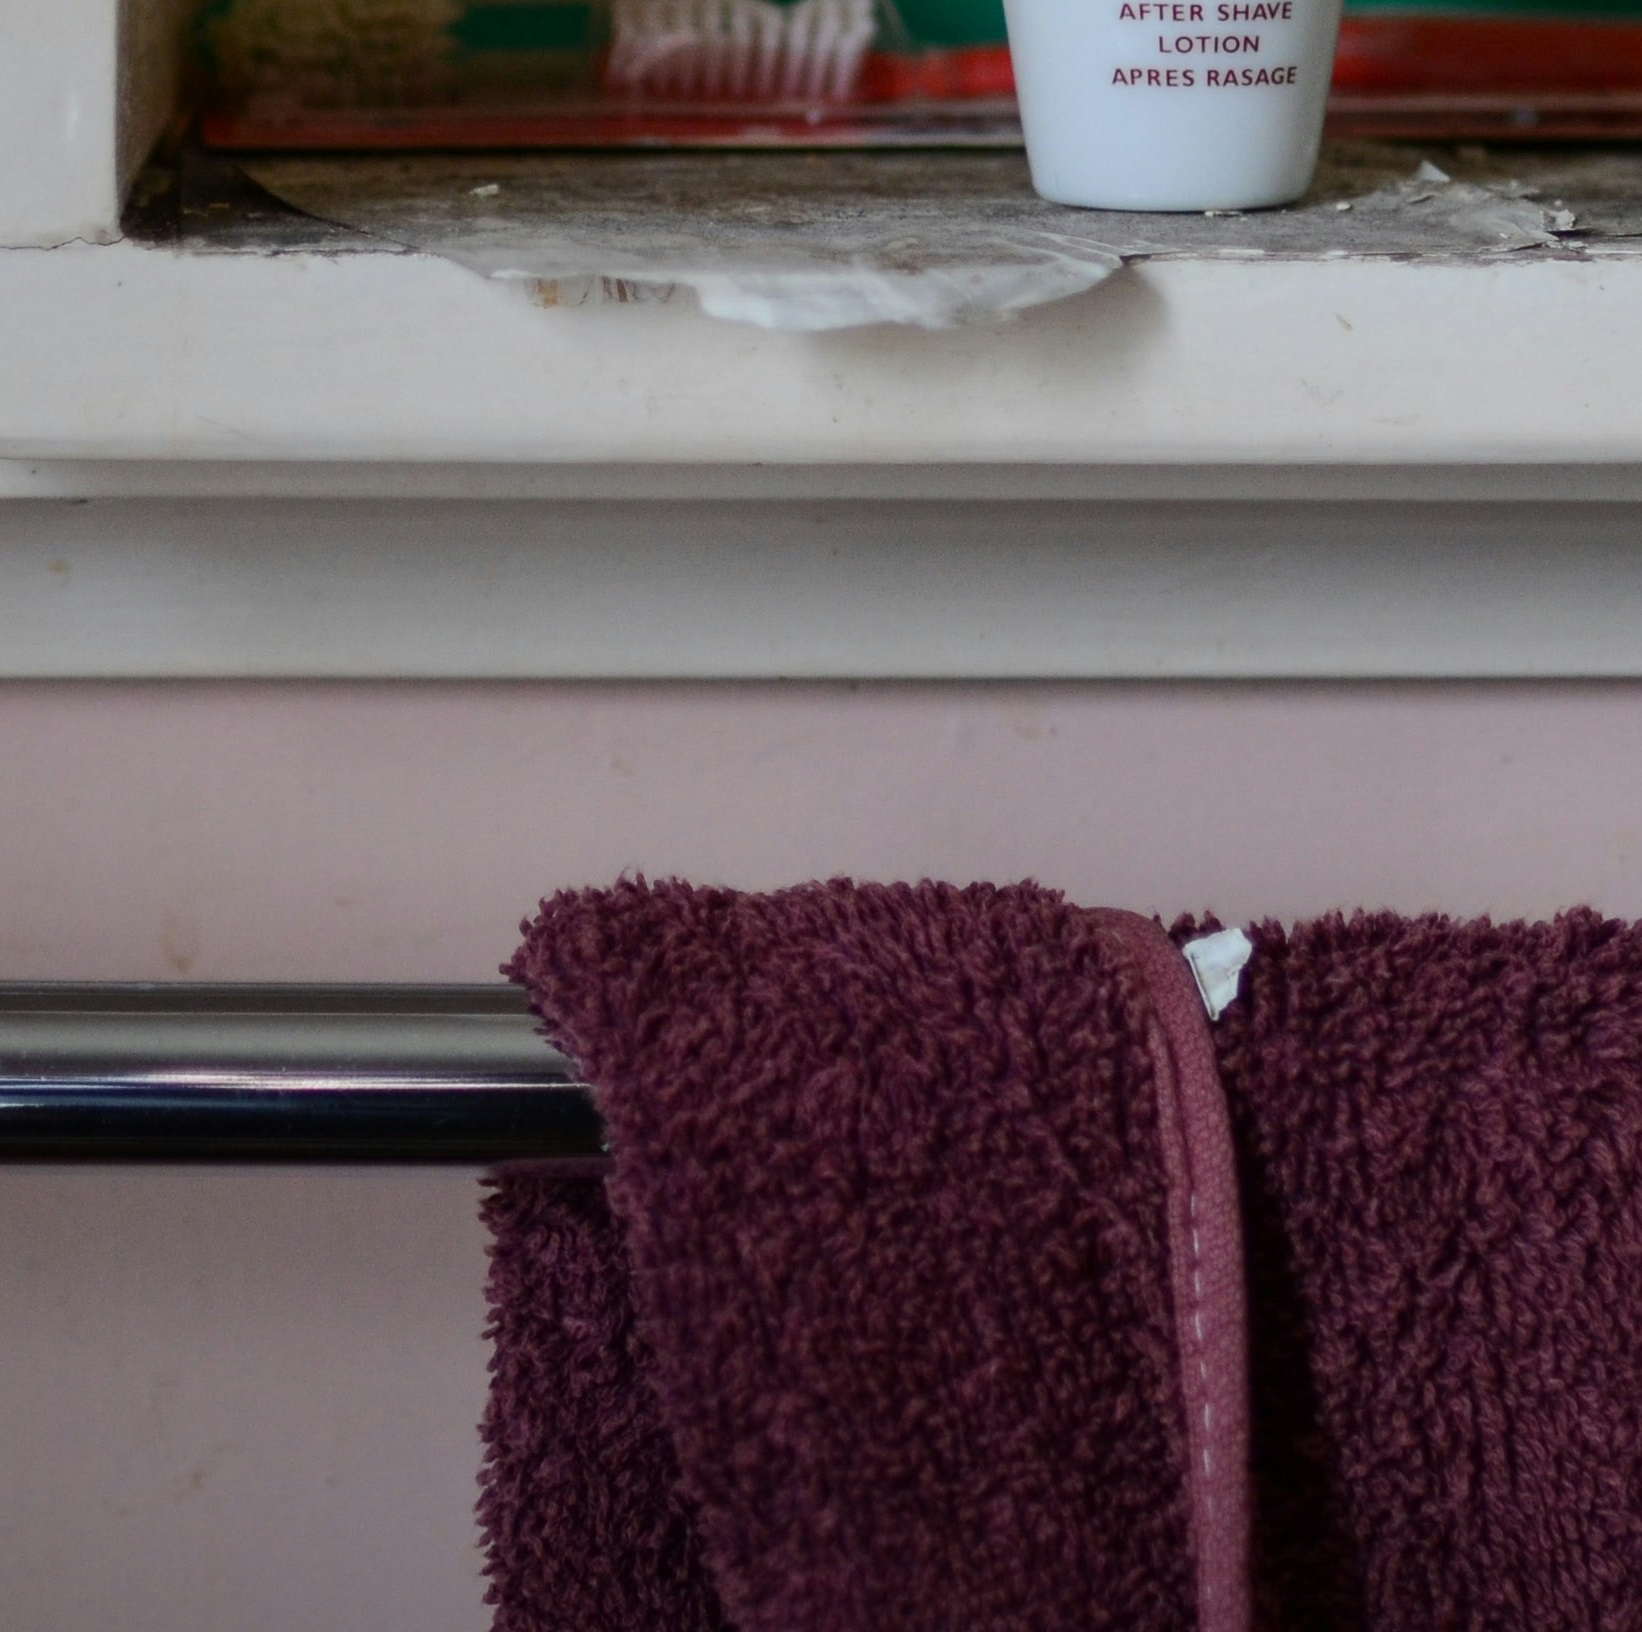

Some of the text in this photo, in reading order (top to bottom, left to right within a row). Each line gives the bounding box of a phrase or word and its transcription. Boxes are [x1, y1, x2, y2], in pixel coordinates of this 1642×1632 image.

[1119, 1, 1293, 22] AFTER SHAVE
[1158, 35, 1259, 54] LOTION
[1112, 66, 1297, 87] APRES RASAGE
